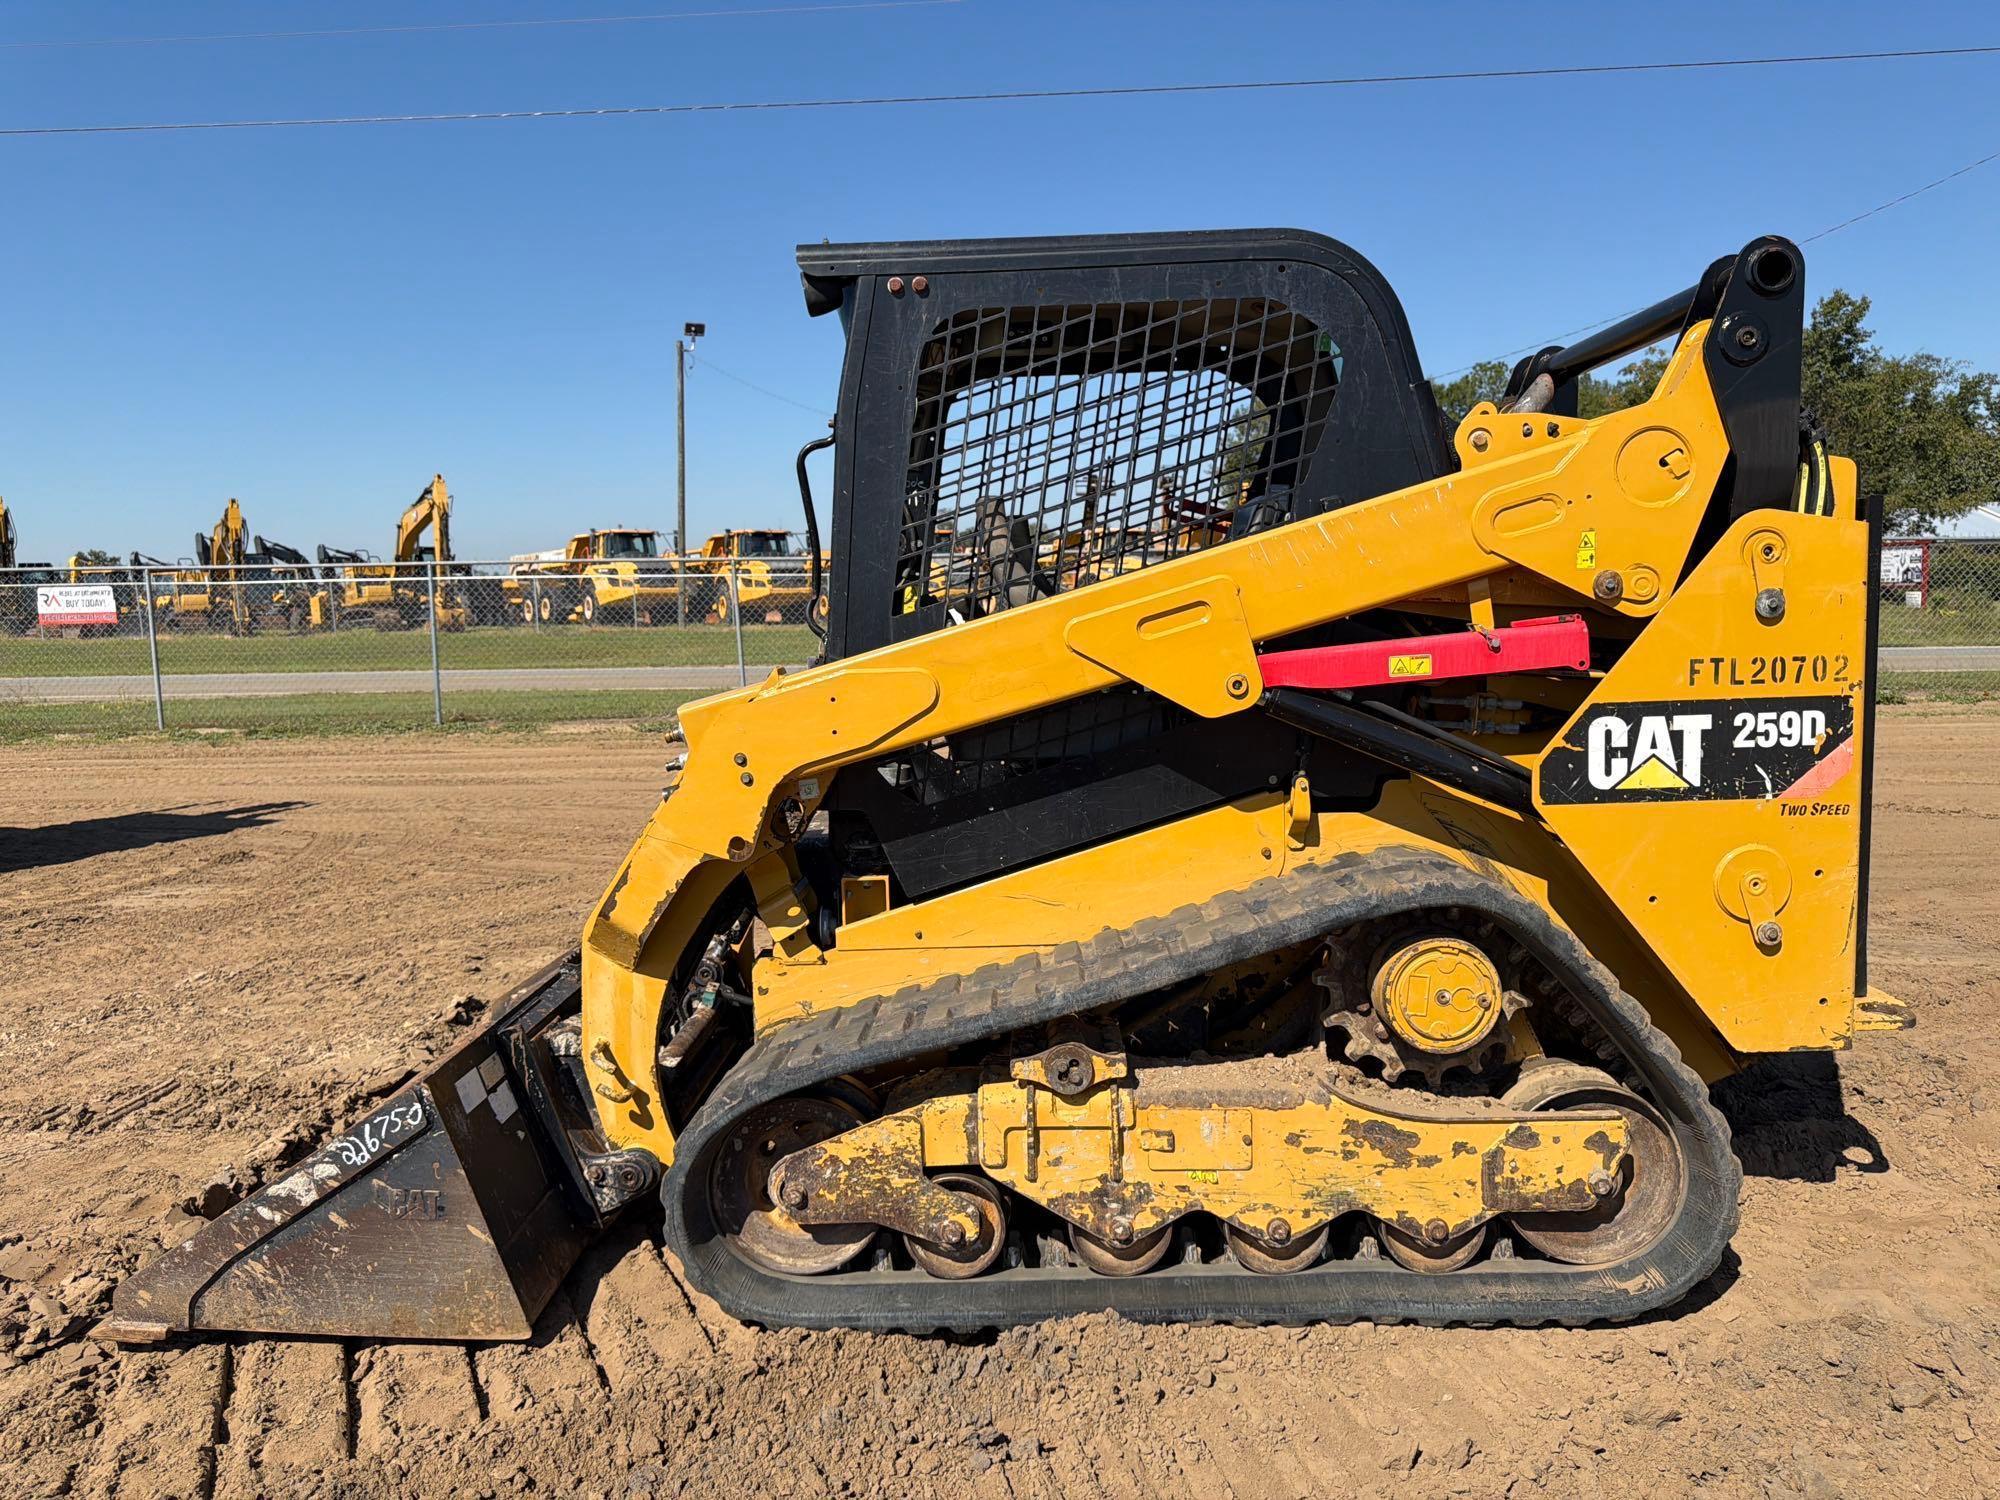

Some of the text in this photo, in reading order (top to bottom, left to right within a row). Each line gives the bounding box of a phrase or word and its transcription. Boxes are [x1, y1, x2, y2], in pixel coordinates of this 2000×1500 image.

[65, 598, 107, 608] BUY TODAY!
[1689, 654, 1849, 687] FTL20702
[1588, 710, 1826, 790] CAT 259D
[336, 1102, 422, 1166] 226750
